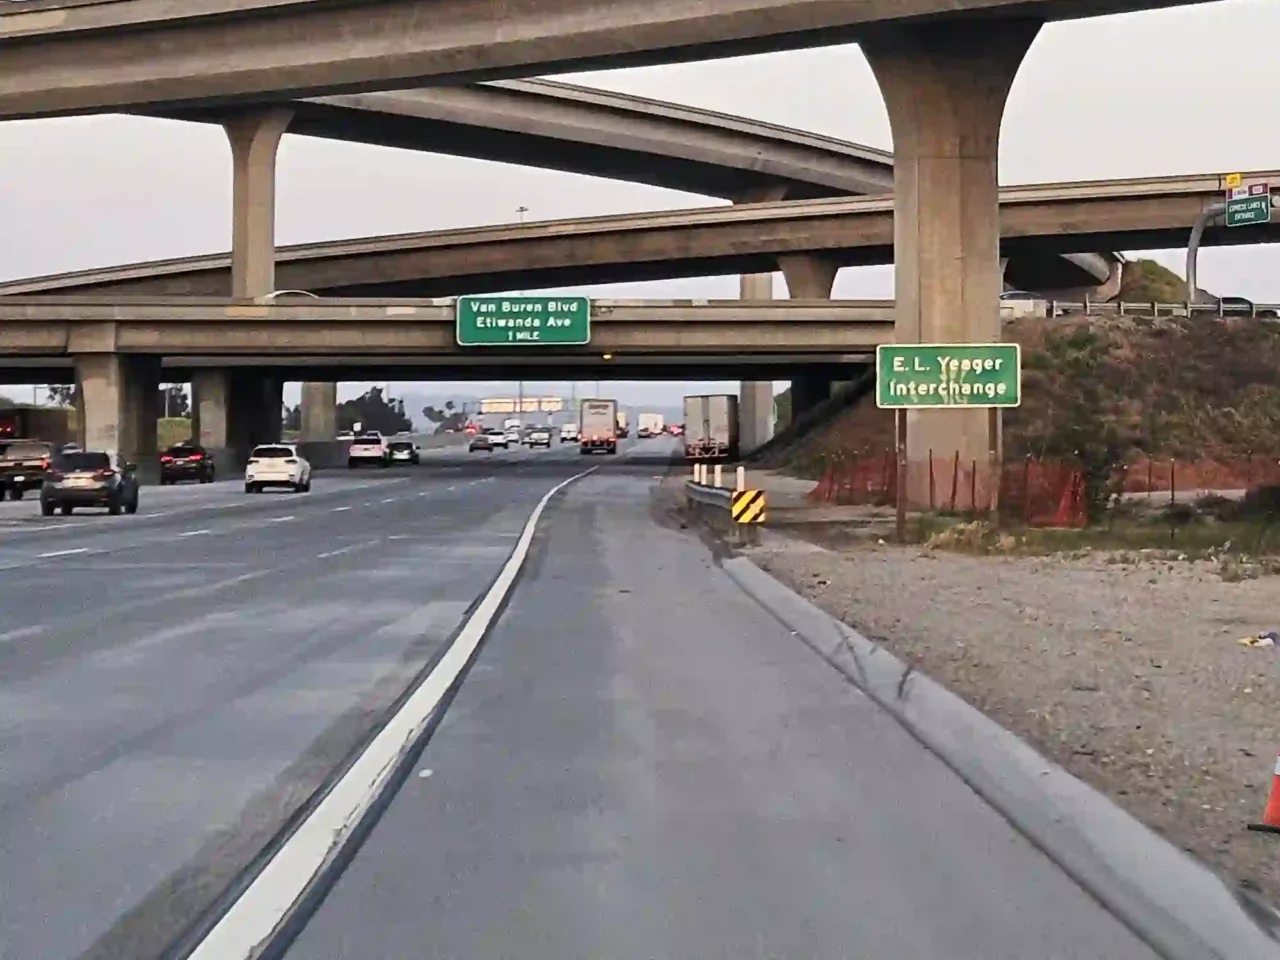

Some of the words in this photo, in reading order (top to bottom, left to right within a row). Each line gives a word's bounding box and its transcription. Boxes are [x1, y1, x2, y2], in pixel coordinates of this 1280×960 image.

[470, 301, 496, 312] Van
[501, 301, 542, 312] Buren
[547, 301, 578, 312] Blvd
[476, 317, 540, 327] Etiwanda
[546, 317, 571, 327] Ave
[508, 331, 513, 340] 1
[516, 331, 540, 340] MILE
[893, 356, 909, 372] E.
[914, 356, 930, 372] L.
[936, 355, 1004, 375] Yeager
[889, 379, 1007, 398] Interchange
